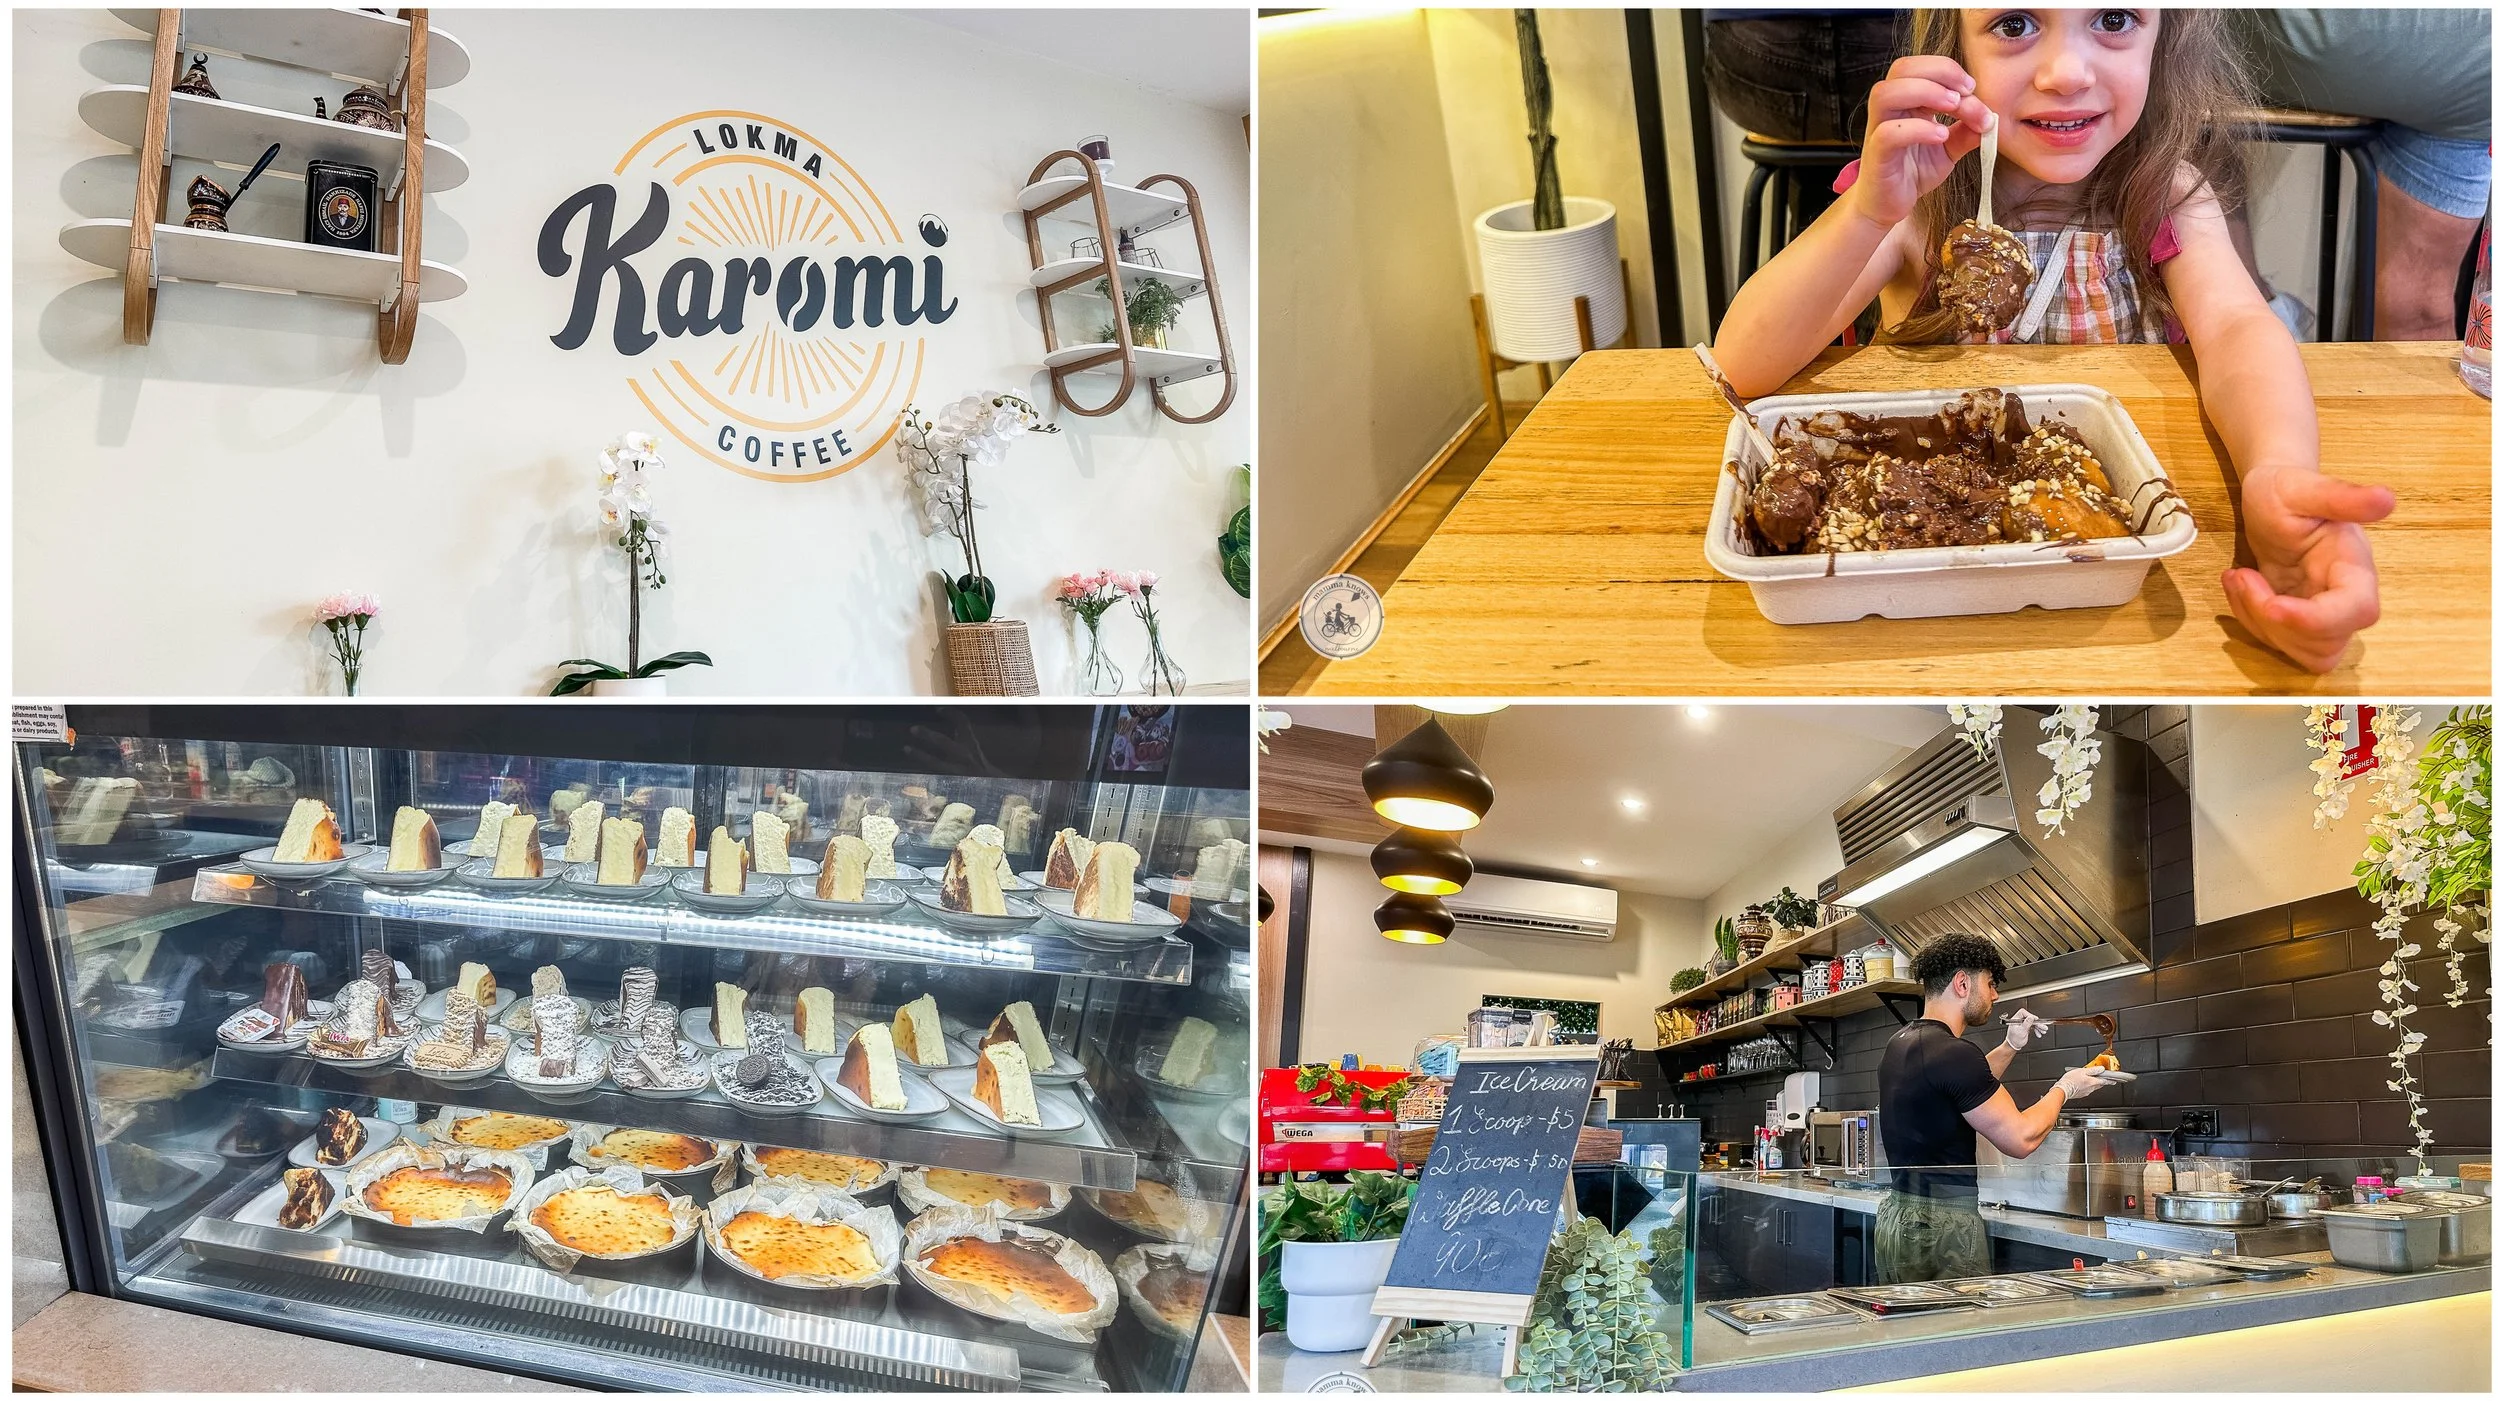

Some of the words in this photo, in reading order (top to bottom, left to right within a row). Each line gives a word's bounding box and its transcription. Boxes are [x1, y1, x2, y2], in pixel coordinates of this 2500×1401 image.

[693, 123, 823, 180] LOKMA
[537, 181, 959, 357] Karomi
[717, 425, 853, 469] COFFEE
[2343, 752, 2358, 763] FIRE
[2351, 757, 2375, 771] UISHER
[1513, 1066, 1587, 1093] Cream
[1286, 1129, 1313, 1137] WEGA
[1442, 1104, 1463, 1134] 1
[1429, 1145, 1452, 1176] 2
[1502, 1188, 1552, 1217] Cone
